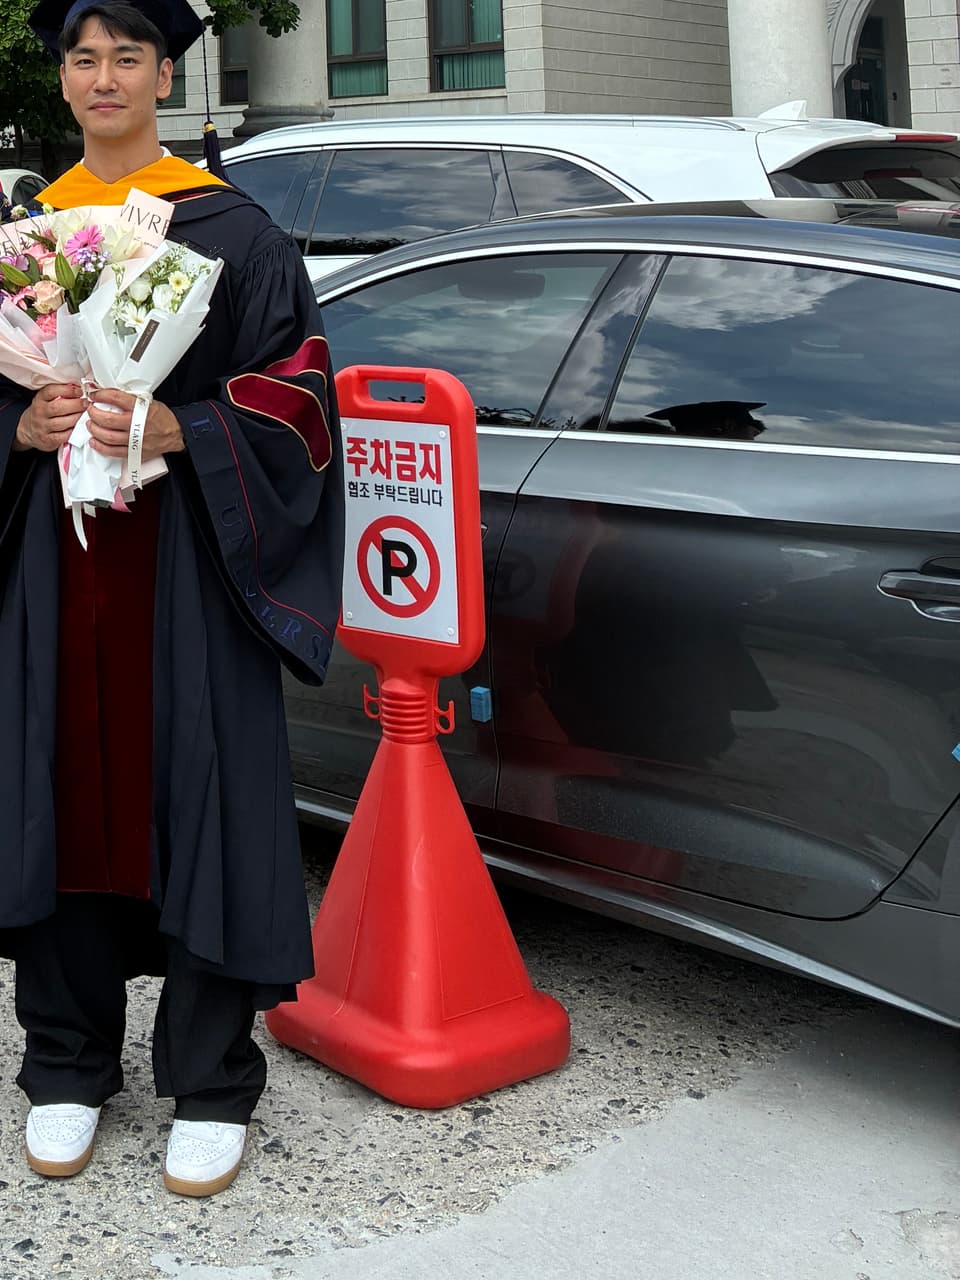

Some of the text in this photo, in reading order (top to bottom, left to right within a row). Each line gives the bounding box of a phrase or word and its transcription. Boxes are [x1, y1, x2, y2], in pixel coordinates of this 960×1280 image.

[132, 423, 141, 451] YLANG
[346, 436, 442, 485] 주차금지
[348, 481, 442, 507] 협조 부탁드립니다
[381, 539, 417, 596] P
